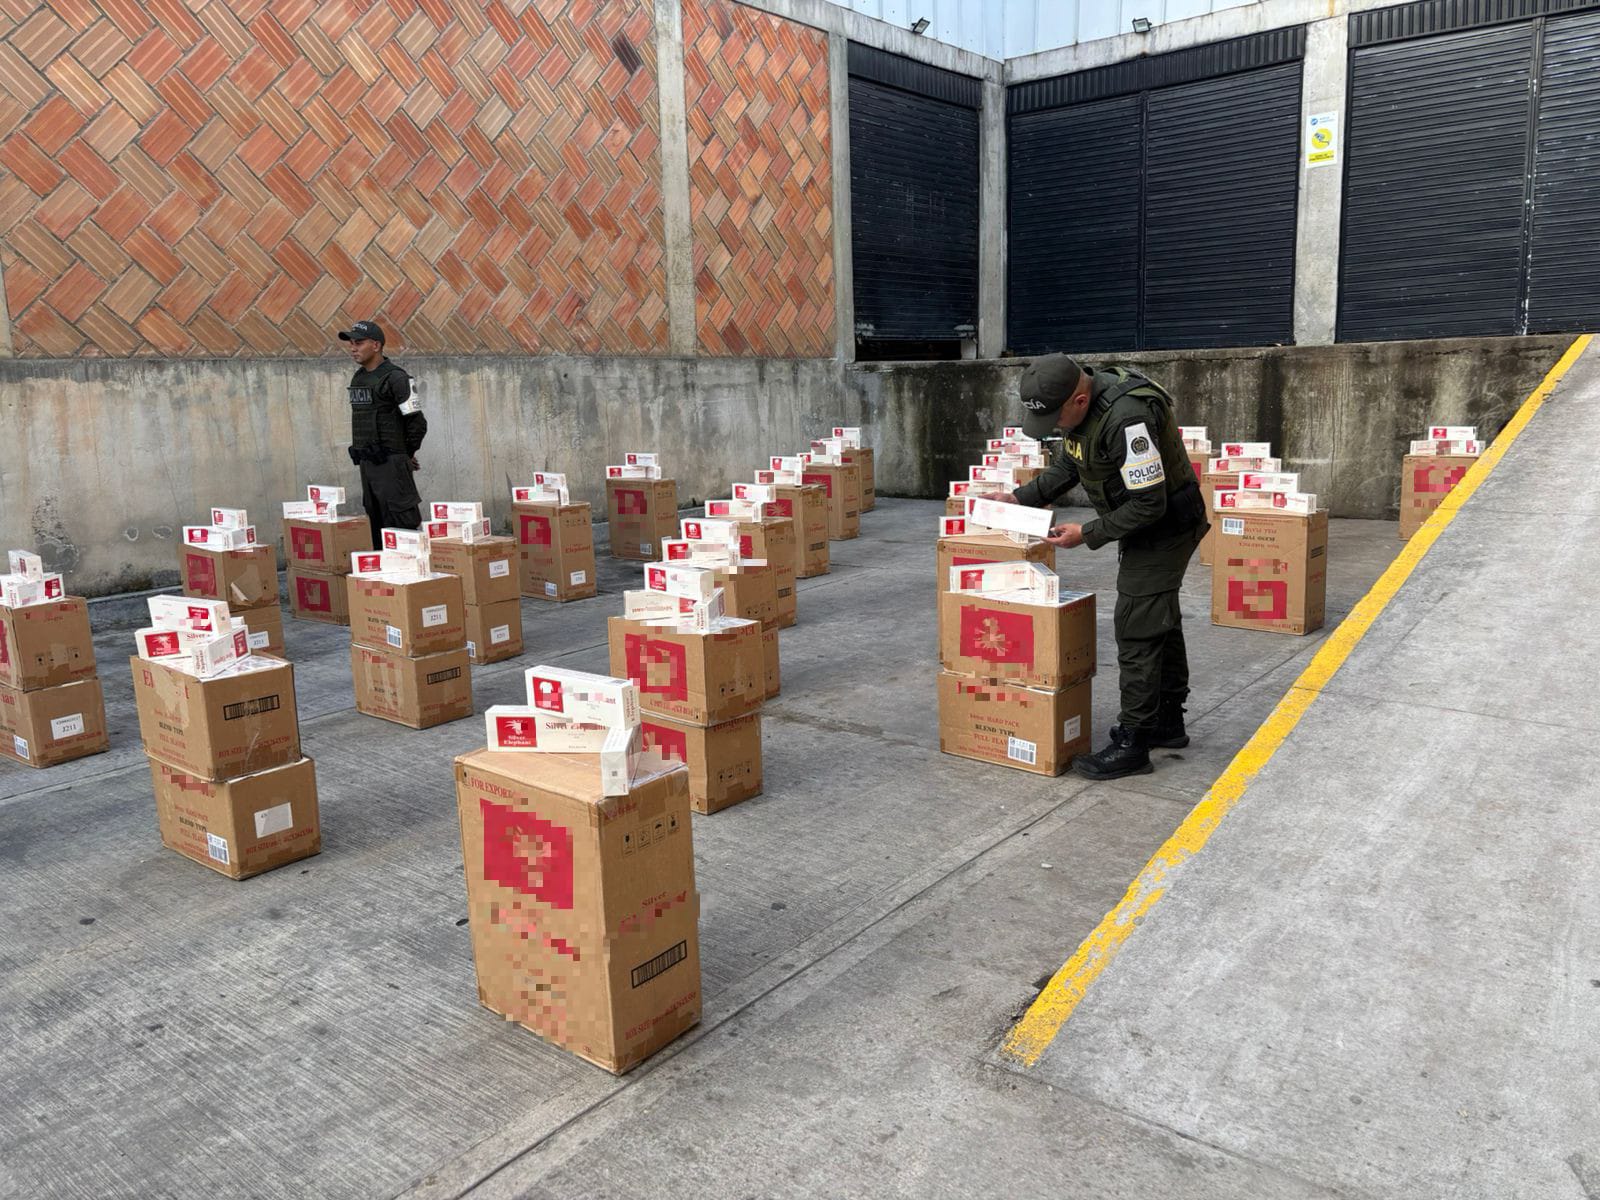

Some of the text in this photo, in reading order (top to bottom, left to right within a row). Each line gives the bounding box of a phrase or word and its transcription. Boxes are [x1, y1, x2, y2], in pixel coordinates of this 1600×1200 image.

[1129, 462, 1162, 480] POLICÍA
[975, 723, 1016, 737] BLEND TYPE
[471, 776, 485, 791] FOR
